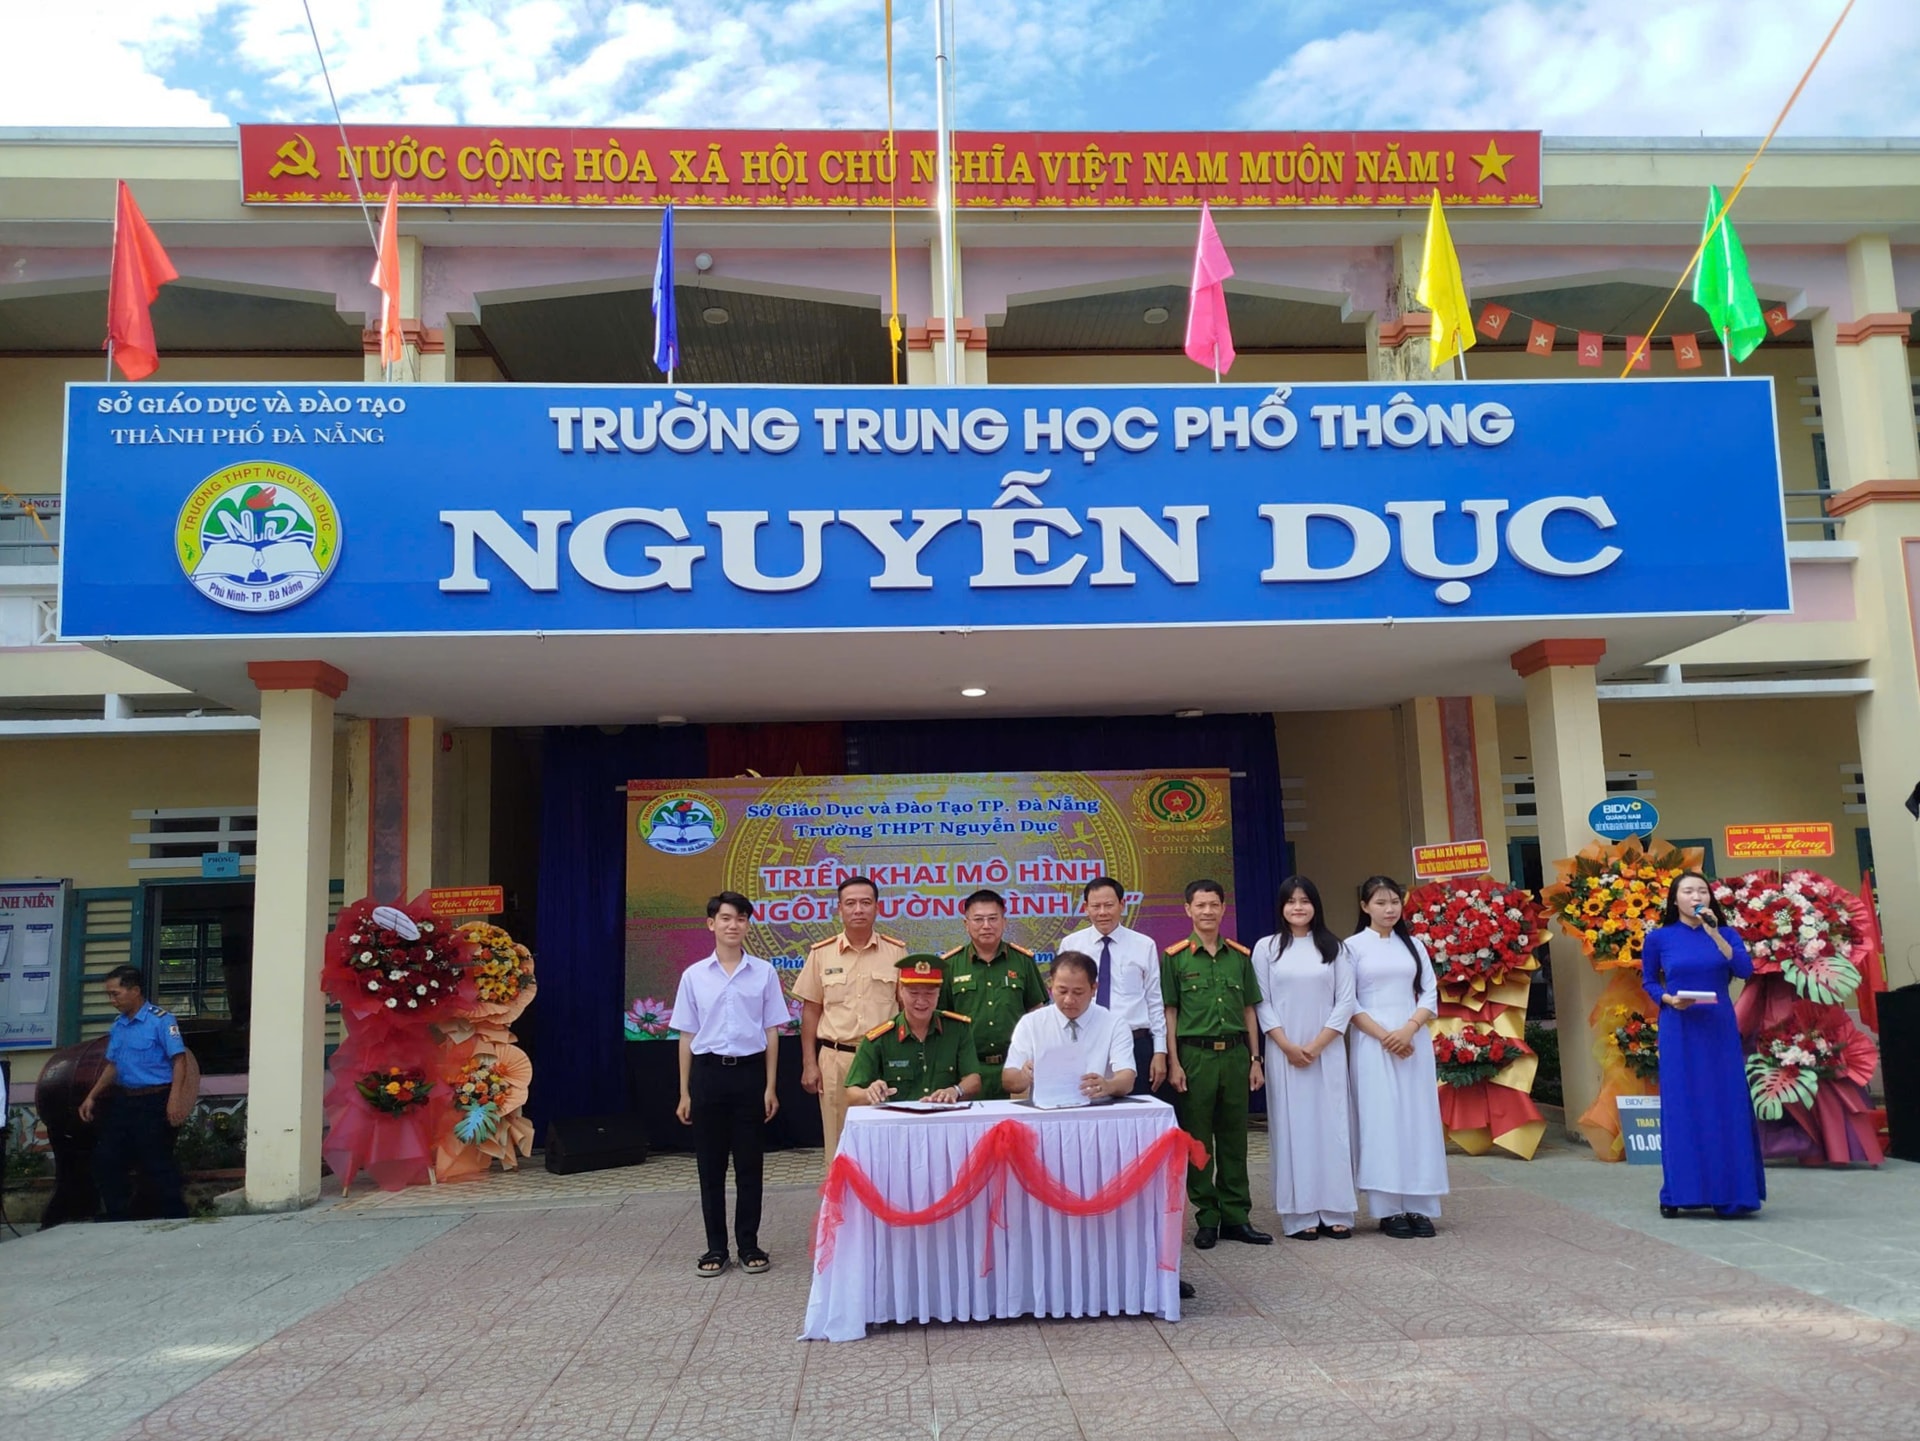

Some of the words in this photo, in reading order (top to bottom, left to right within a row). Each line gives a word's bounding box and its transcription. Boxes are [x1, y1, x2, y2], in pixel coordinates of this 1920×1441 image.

[337, 135, 447, 180] NƯỚC
[457, 138, 565, 188] CỘNG
[574, 138, 657, 182] HÒA
[670, 143, 730, 183] XÃ
[741, 142, 808, 192] HỘI
[819, 138, 898, 184] CHỦ
[1039, 143, 1132, 191] VIỆT
[1143, 152, 1229, 184] NAM
[1240, 142, 1345, 184] MUÔN
[97, 390, 132, 414] SỞ
[138, 391, 203, 414] GIÁO
[207, 397, 257, 418] DỤC
[262, 390, 293, 414] VÀ
[299, 390, 351, 414] ĐÀO
[357, 397, 406, 418] TẠO
[111, 423, 203, 444] THÀNH
[212, 420, 264, 445] PHỐ
[272, 424, 306, 444] ĐÀ
[314, 421, 384, 444] NẴNG
[549, 389, 800, 454] TRƯỜNG
[815, 407, 1009, 454] TRUNG
[1024, 405, 1159, 463] HỌC
[1173, 386, 1298, 451] PHỔ
[1310, 392, 1515, 449] THÔNG
[184, 481, 222, 531] TRƯỜNG
[223, 467, 262, 484] THPT
[439, 468, 1211, 593] NGUYỄN
[1258, 495, 1624, 605] DỤC
[747, 804, 772, 818] Sở
[777, 803, 821, 817] Giáo
[826, 803, 864, 818] Dục
[868, 803, 891, 815] và
[896, 801, 932, 815] Đào
[937, 801, 973, 815] Tạo
[978, 800, 1010, 812] TP.
[1018, 799, 1043, 811] Đà
[1048, 796, 1099, 813] Nẵng
[1603, 804, 1631, 813] BIDV
[795, 823, 873, 838] Trường
[878, 821, 935, 835] THPT
[940, 817, 1016, 836] Nguyễn
[1020, 820, 1058, 834] Dục
[1153, 834, 1188, 843] CÔNG
[1192, 834, 1210, 843] AN
[1192, 845, 1225, 854] NINH
[763, 860, 857, 888] TRIỂN
[870, 865, 946, 885] KHAI
[957, 860, 1008, 883] MÔ
[1020, 859, 1101, 883] HÌNH
[22, 891, 55, 909] NIÊN
[1635, 1118, 1655, 1128] TRAO
